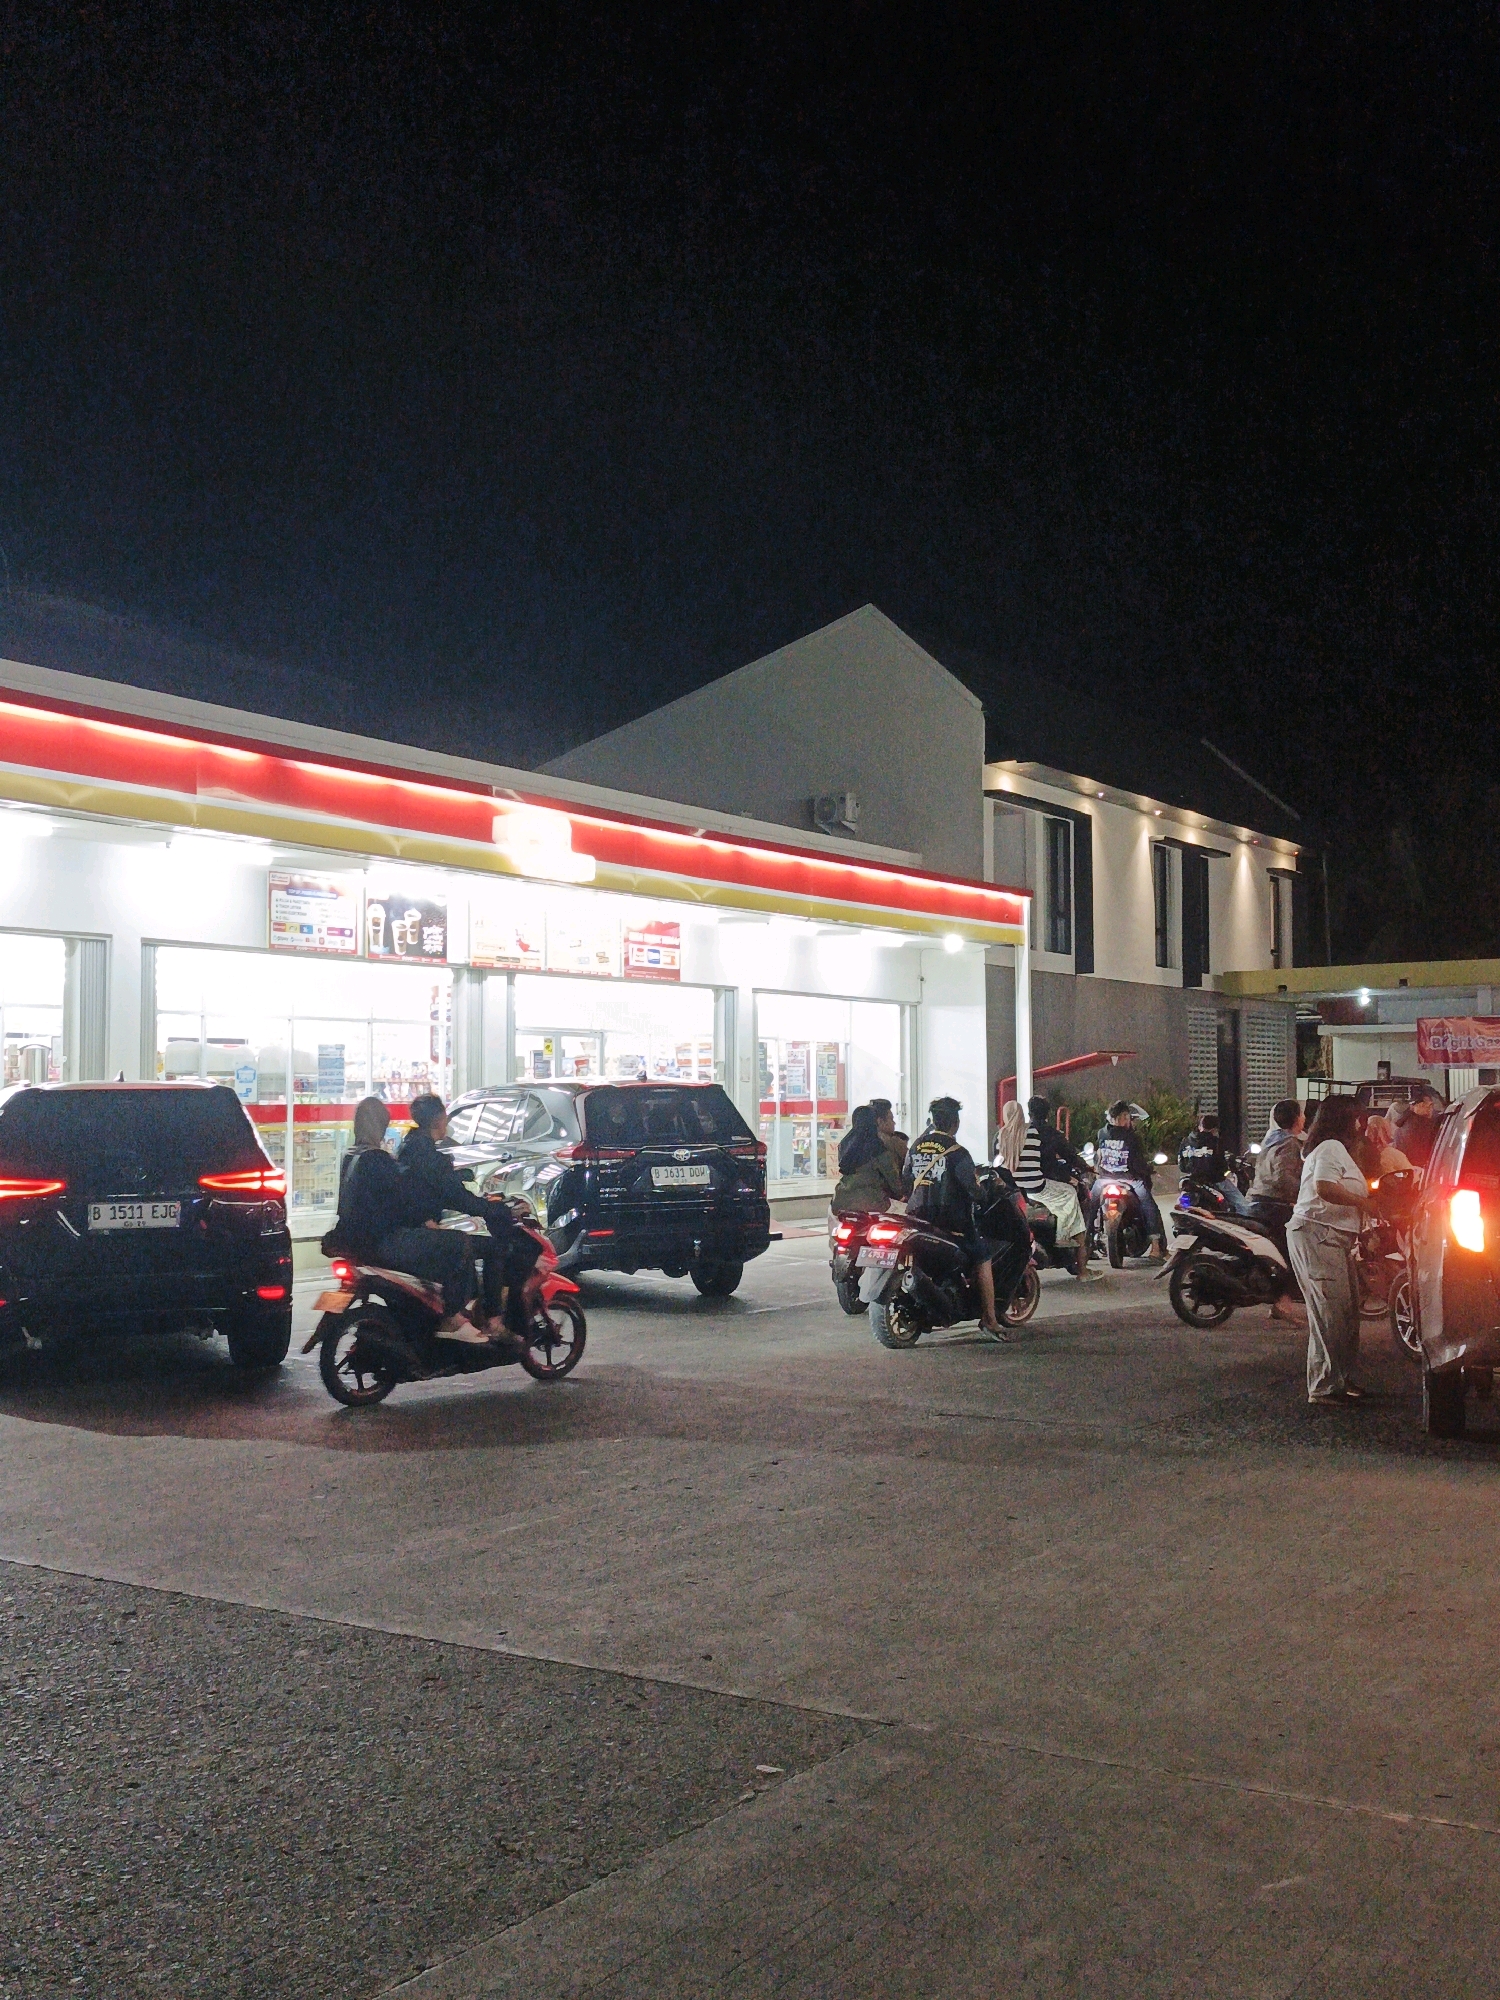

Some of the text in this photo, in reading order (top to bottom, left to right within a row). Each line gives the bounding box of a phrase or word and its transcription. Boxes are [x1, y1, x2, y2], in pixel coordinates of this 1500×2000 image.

[654, 1168, 660, 1179] B
[664, 1167, 685, 1179] 1631
[92, 1204, 177, 1220] B 1511 EJG
